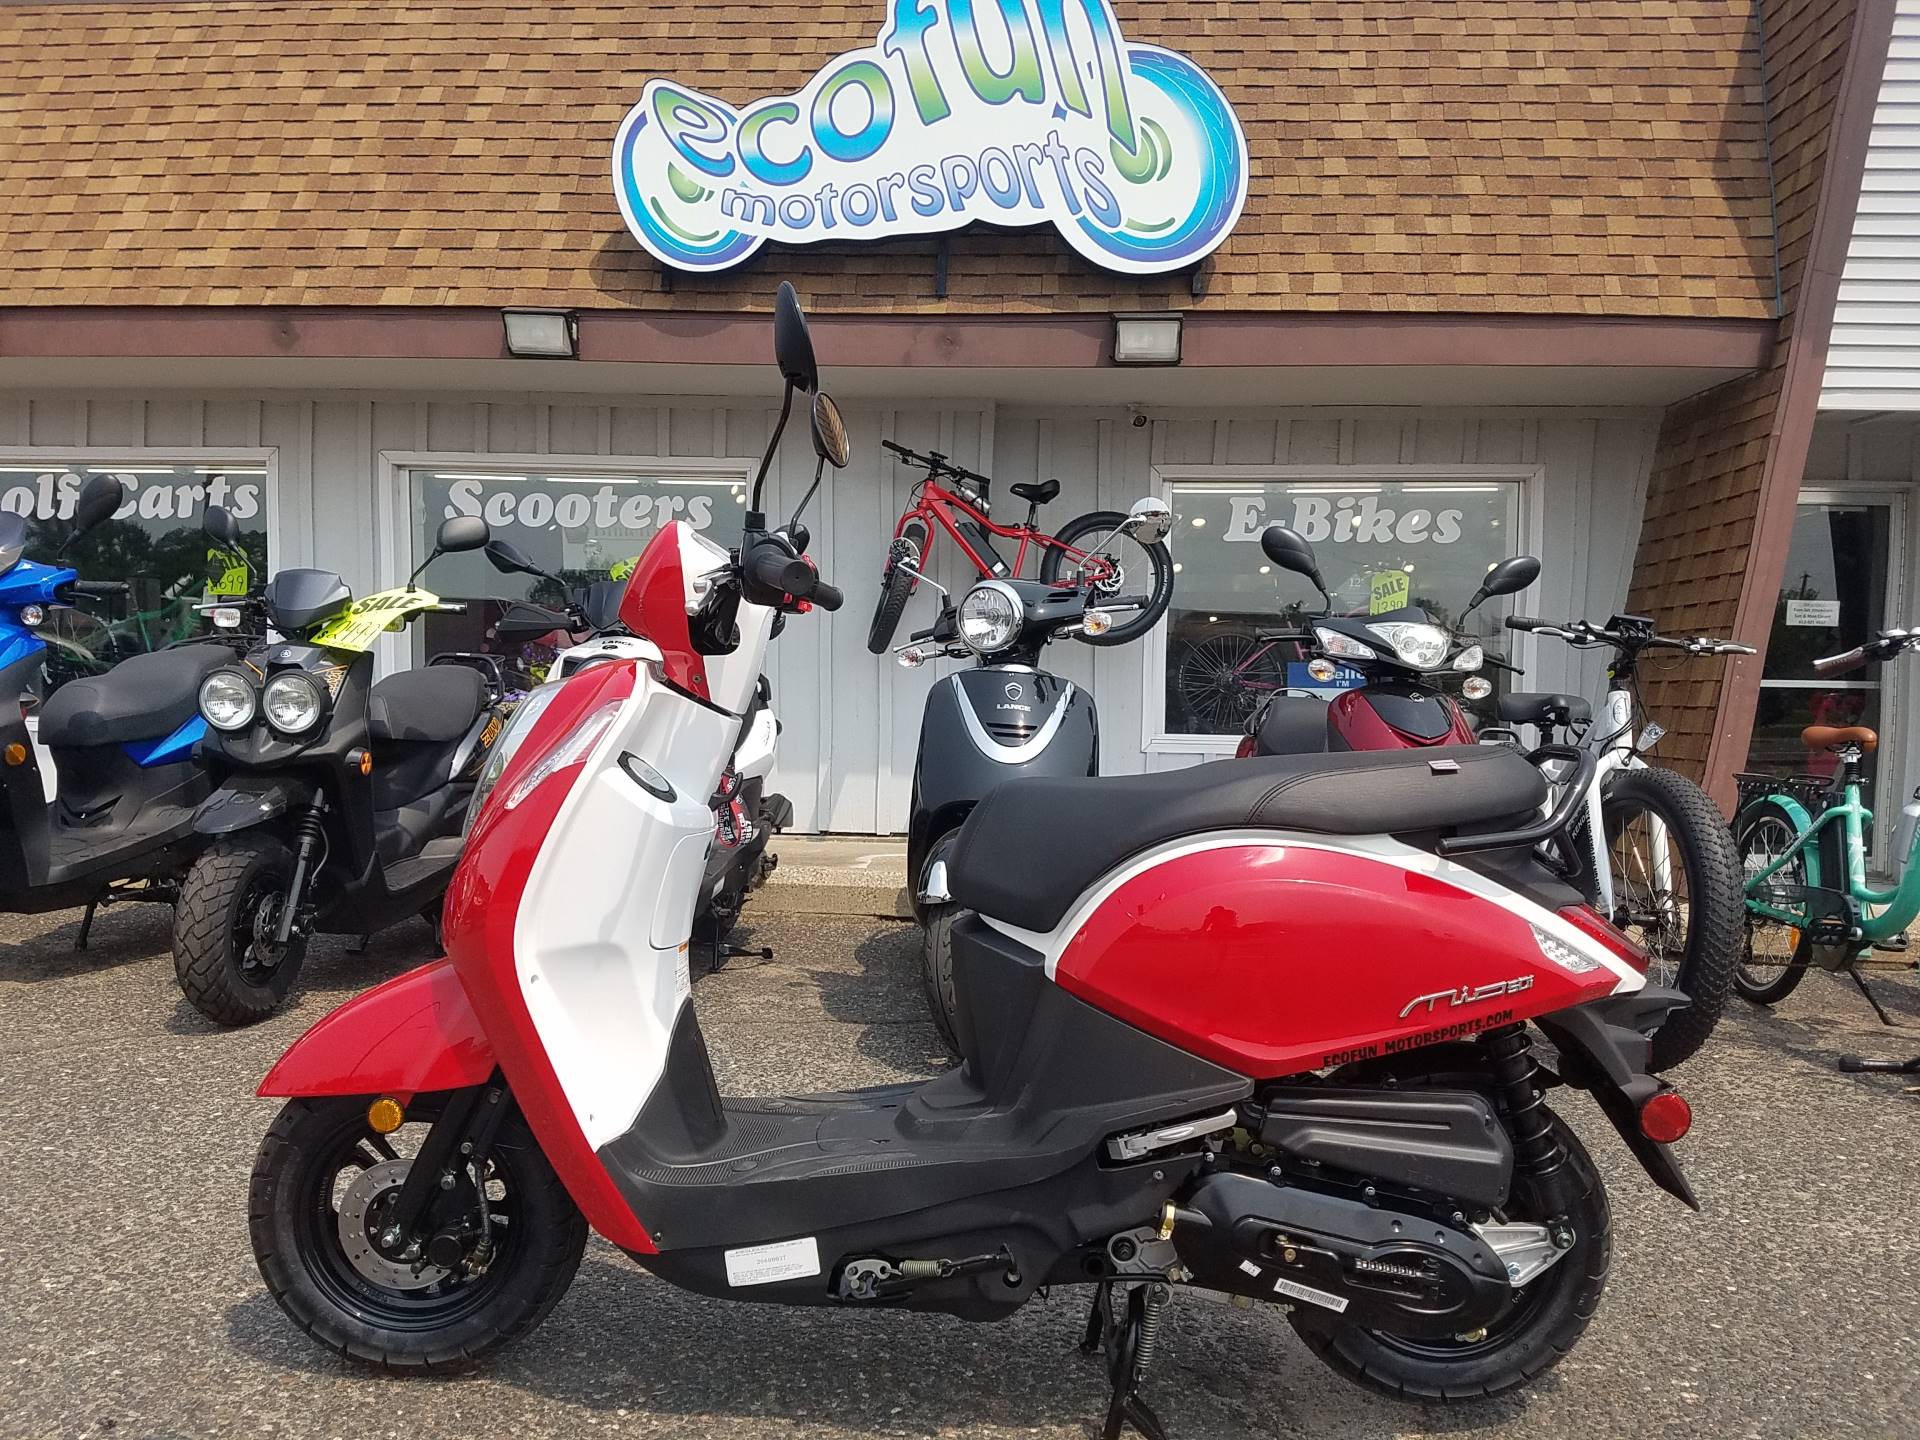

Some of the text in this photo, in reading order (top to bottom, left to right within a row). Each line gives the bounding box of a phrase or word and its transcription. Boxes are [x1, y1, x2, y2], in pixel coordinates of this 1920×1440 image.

[720, 129, 1123, 231] motorsports
[109, 474, 259, 520] Carts
[443, 479, 714, 531] Scooters
[1223, 496, 1463, 545] E-Bikes
[351, 596, 423, 615] SALE
[1373, 577, 1406, 601] SALE
[996, 703, 1032, 712] LANCE
[1322, 1009, 1513, 1068] ECOFUN MOTORSPORTS.COM
